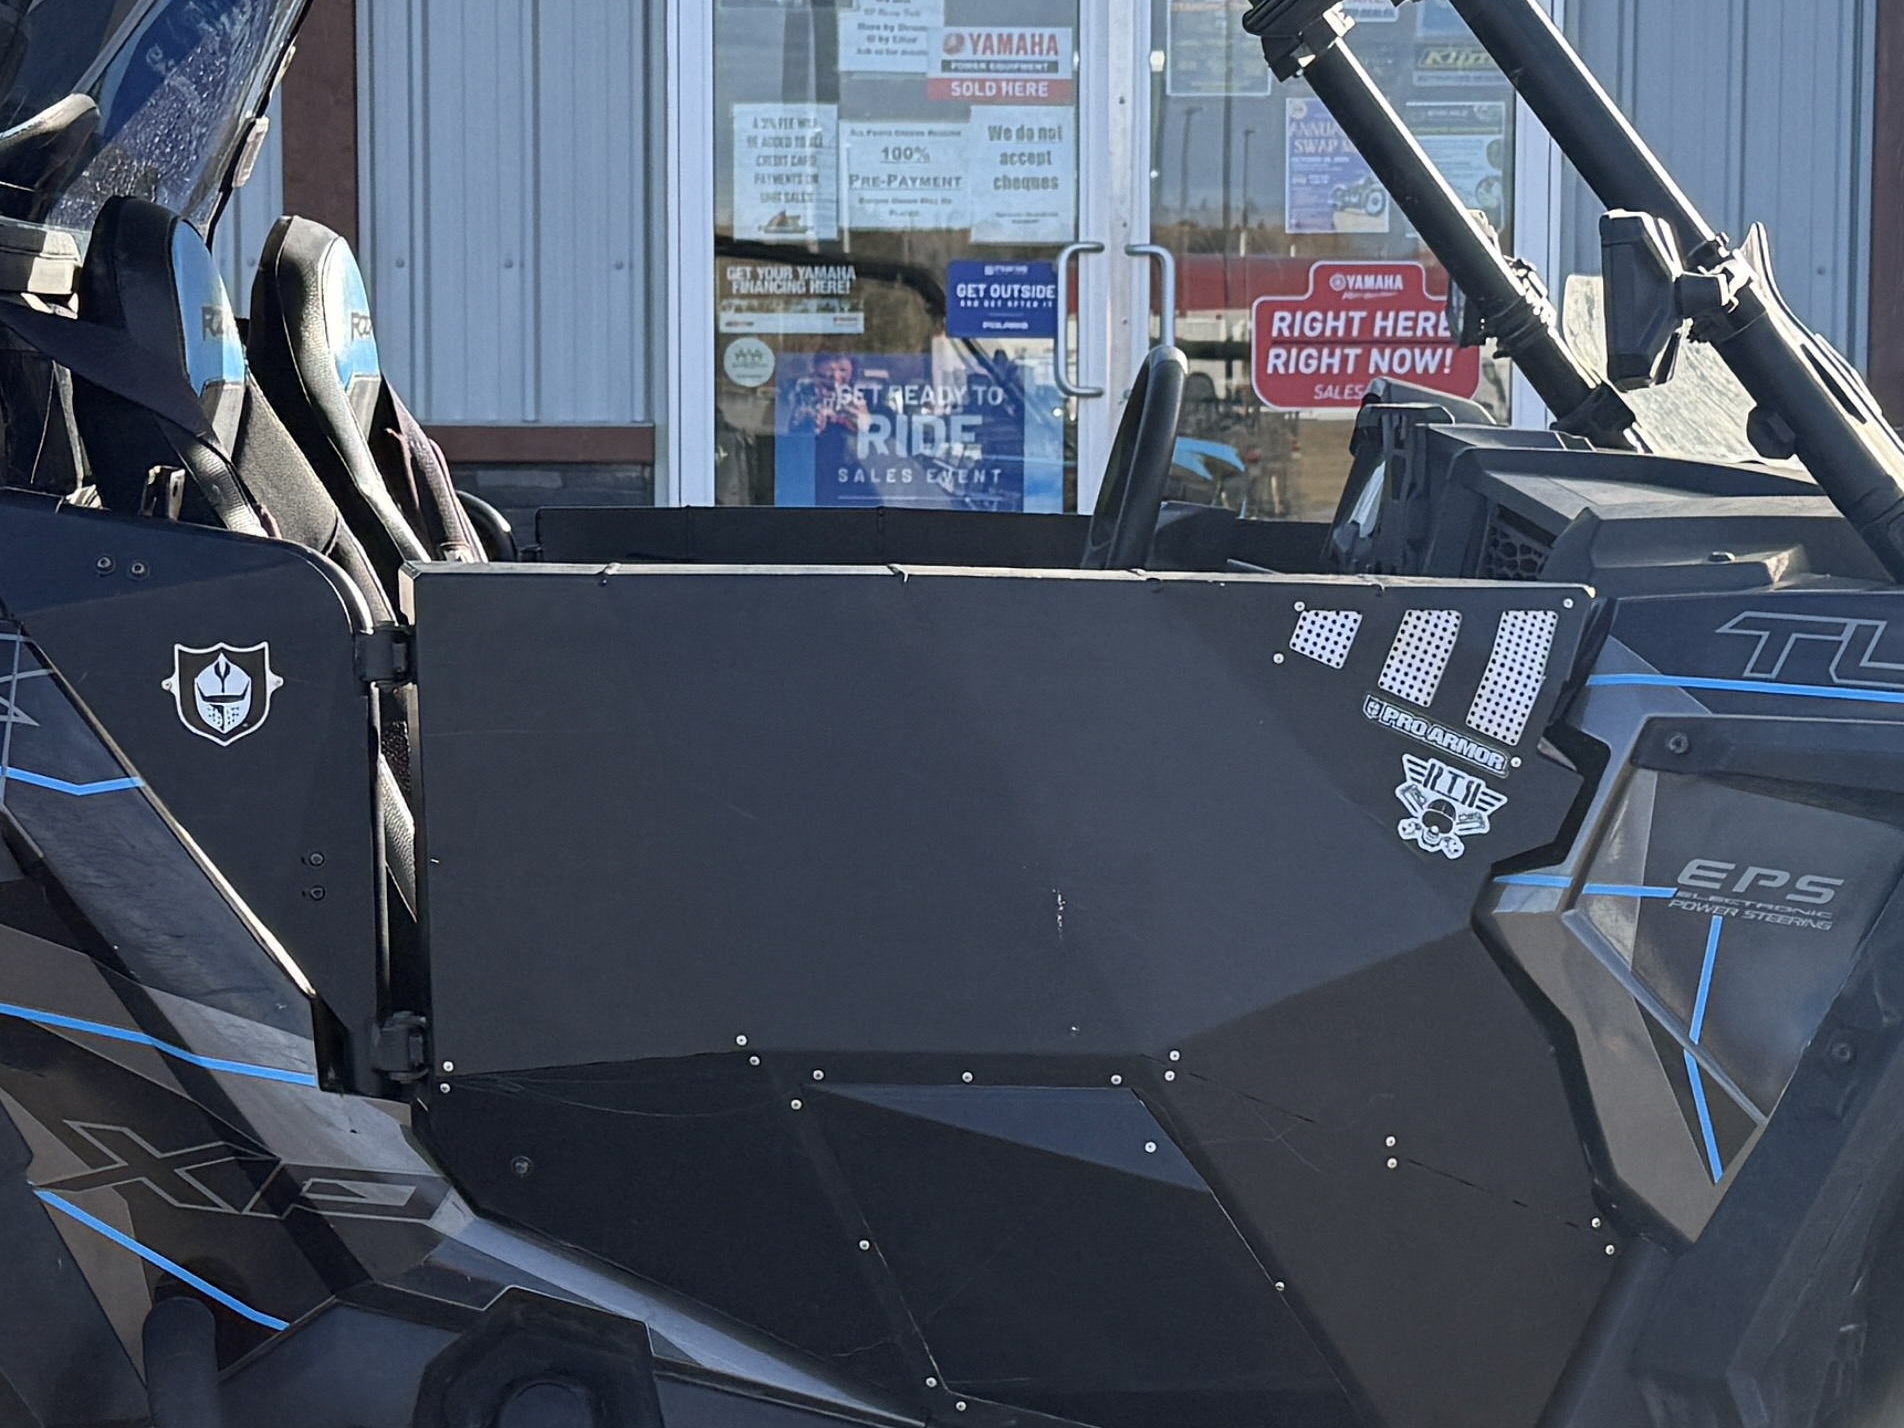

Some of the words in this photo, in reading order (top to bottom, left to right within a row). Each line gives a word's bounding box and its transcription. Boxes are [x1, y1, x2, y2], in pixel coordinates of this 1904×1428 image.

[969, 32, 1058, 56] YAMAHA
[951, 81, 996, 97] SOLD
[1001, 81, 1049, 97] HERE
[988, 125, 1012, 141] We
[1016, 125, 1035, 141] do
[1038, 125, 1063, 141] not
[1288, 121, 1343, 138] ANNUA
[881, 146, 931, 162] 100%
[1294, 139, 1338, 153] SWAP
[999, 150, 1052, 166] accept
[993, 174, 1059, 191] cheques
[726, 266, 753, 280] GET
[757, 266, 793, 280] YOUR
[797, 265, 856, 281] YAMAHA
[732, 280, 806, 294] FINANCING
[809, 280, 851, 294] HERE!
[957, 283, 987, 298] GET
[990, 284, 1056, 299] OUTSIDE
[1346, 275, 1404, 291] YAMAHA
[1271, 310, 1367, 338] RIGHT
[1373, 310, 1452, 338] HERE
[1266, 348, 1362, 374] RIGHT
[1368, 348, 1454, 374] NOW!
[838, 386, 883, 405] GET
[972, 386, 1004, 406] TO
[1314, 384, 1366, 400] SALES
[857, 414, 983, 460] RIDE
[838, 468, 913, 484] SALES
[926, 468, 1003, 484] EVENT
[1383, 706, 1428, 735] PRO
[1428, 727, 1505, 770] ARMOR
[1677, 858, 1845, 904] EPS
[1676, 890, 1833, 919] ELECTRONIC
[1668, 899, 1739, 917] POWER
[1742, 910, 1833, 931] STEERING
